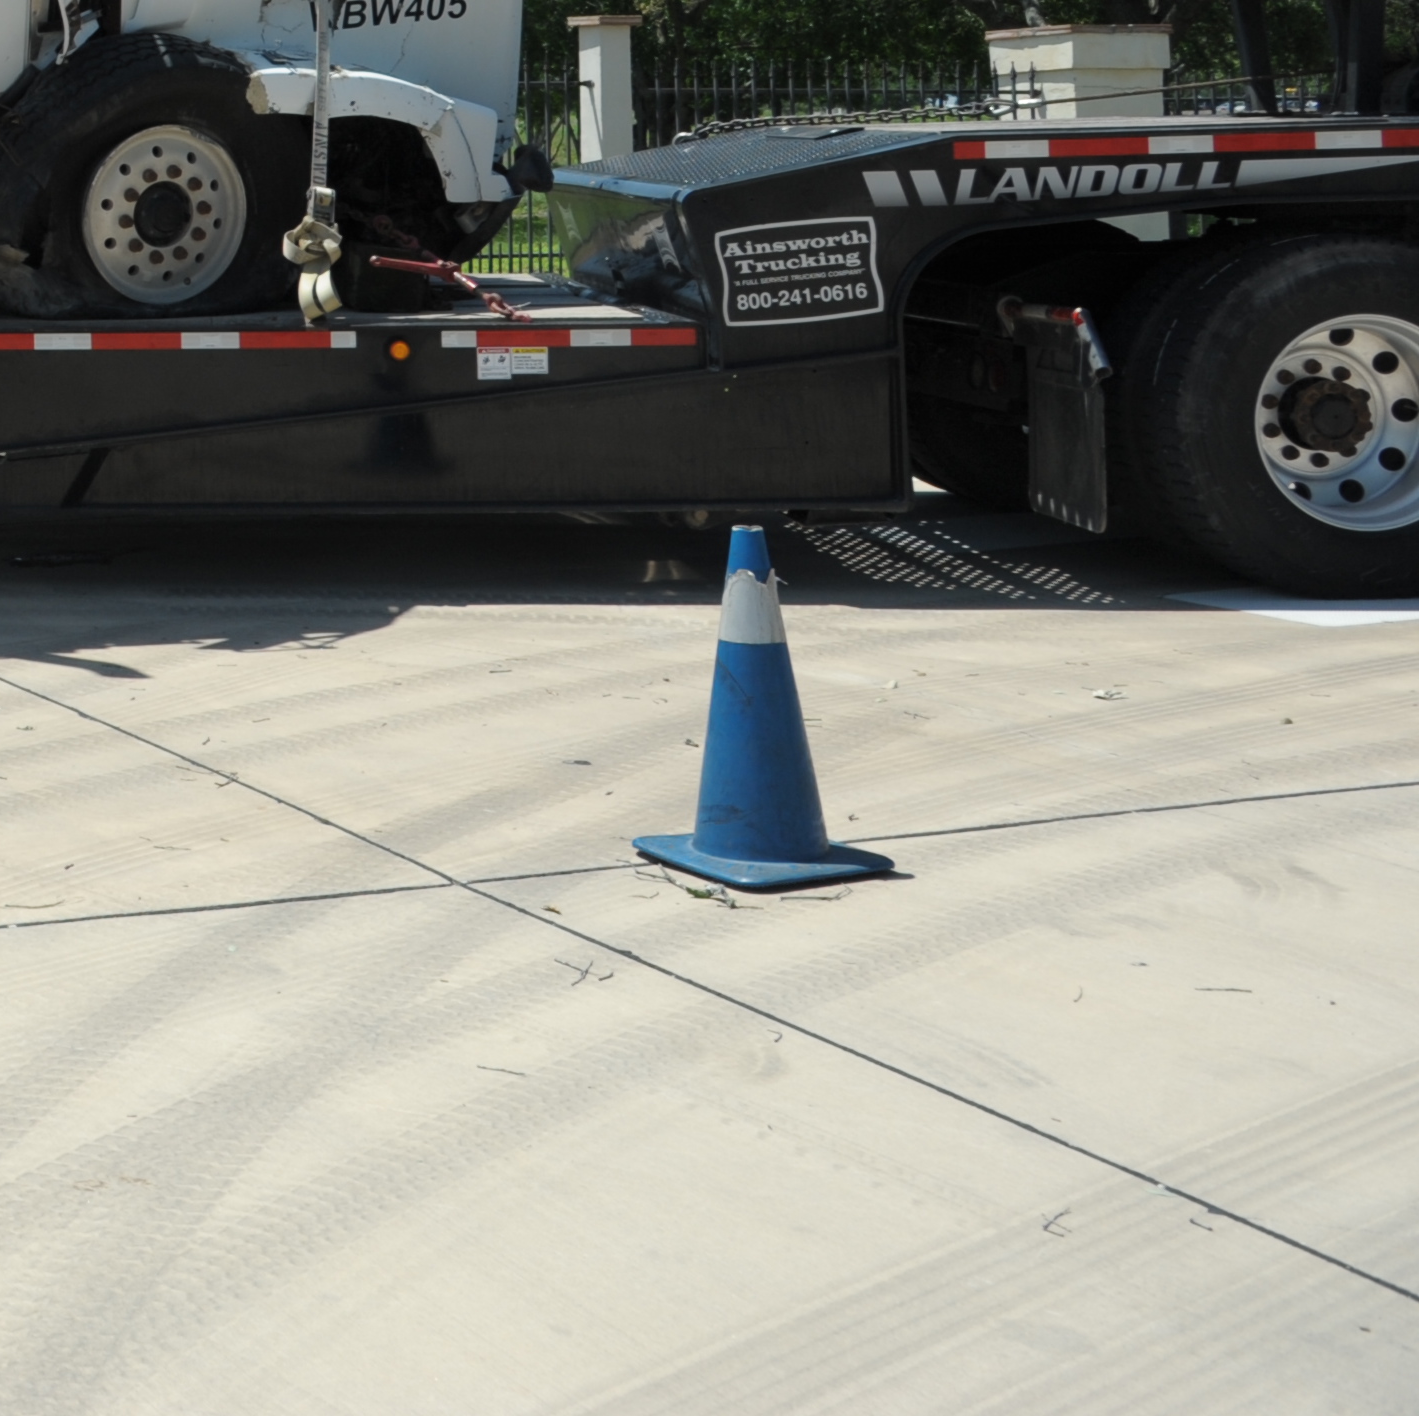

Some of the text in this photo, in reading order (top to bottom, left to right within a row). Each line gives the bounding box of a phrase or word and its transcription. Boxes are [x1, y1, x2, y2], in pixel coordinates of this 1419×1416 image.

[954, 161, 1232, 205] LANDOLL
[723, 230, 869, 258] Ainsworth
[735, 252, 861, 274] Trucking
[760, 275, 789, 284] SERVICE
[791, 272, 827, 282] TRUCKING
[737, 282, 868, 310] 800-241-0616
